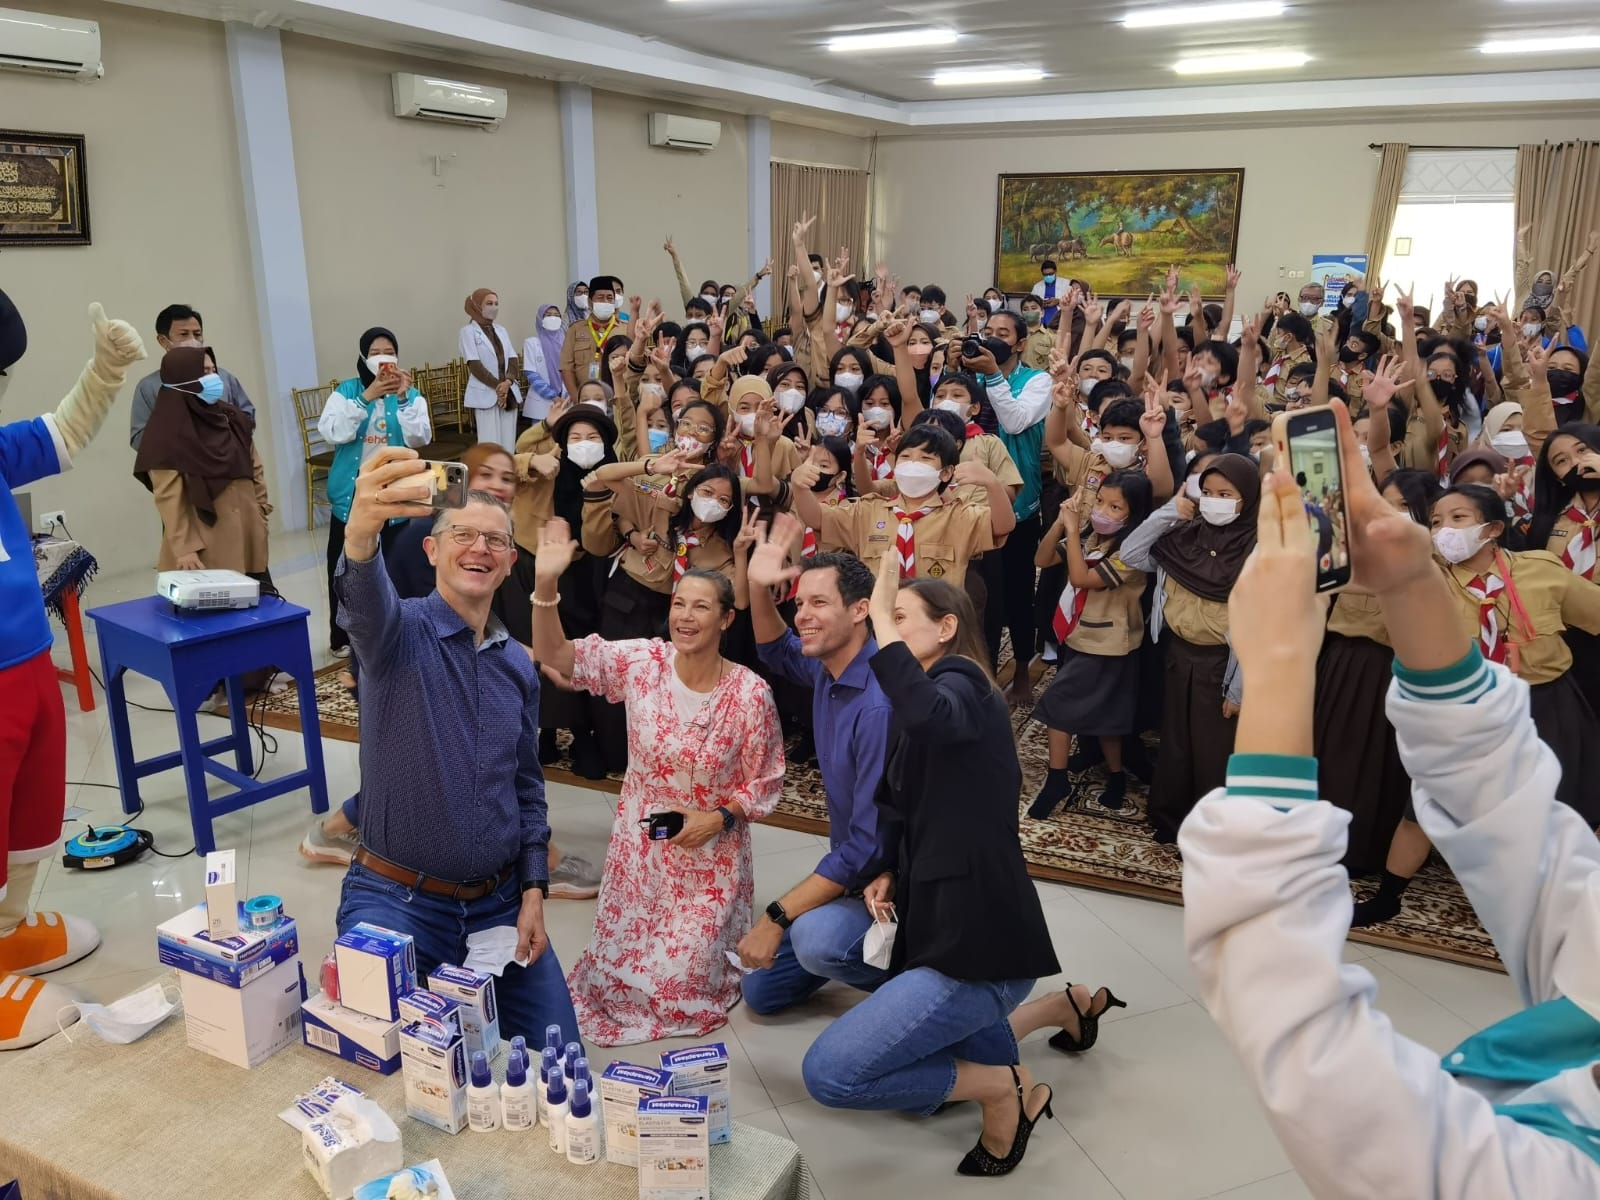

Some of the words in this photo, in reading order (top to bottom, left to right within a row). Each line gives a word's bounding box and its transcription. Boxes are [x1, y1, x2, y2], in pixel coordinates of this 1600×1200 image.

[674, 1051, 715, 1063] Hansaplast
[616, 1069, 656, 1083] Hansaplast
[651, 1102, 695, 1110] Hansaplast
